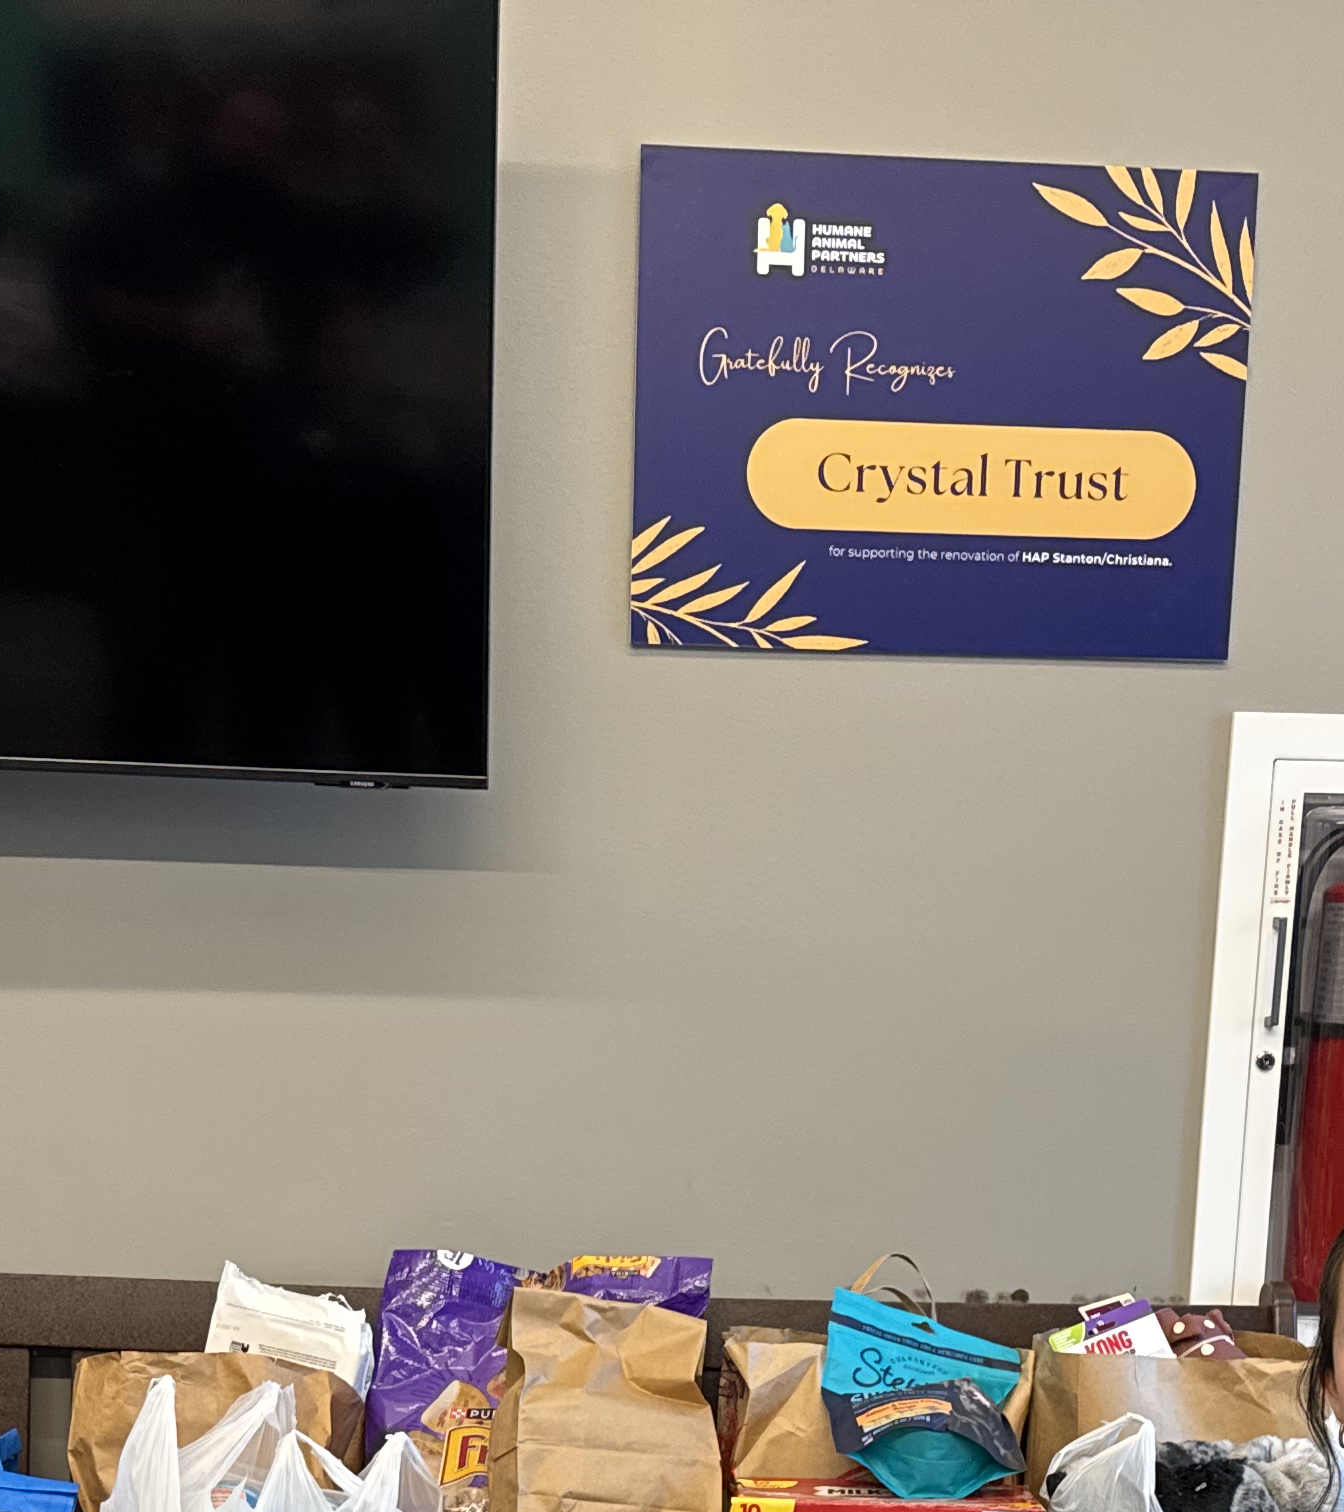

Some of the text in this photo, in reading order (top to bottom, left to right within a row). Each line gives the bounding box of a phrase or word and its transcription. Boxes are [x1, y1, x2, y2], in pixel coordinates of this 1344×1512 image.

[812, 223, 872, 238] HUMANE
[811, 236, 865, 250] ANIMAL
[811, 250, 885, 264] PARTNERS
[810, 264, 884, 276] DELAWARE
[699, 326, 955, 396] Gratefully Recognizes
[817, 452, 1129, 504] Crystal Trust
[828, 545, 1173, 567] for supporting the renovation of HAP Stanton/Christiana.
